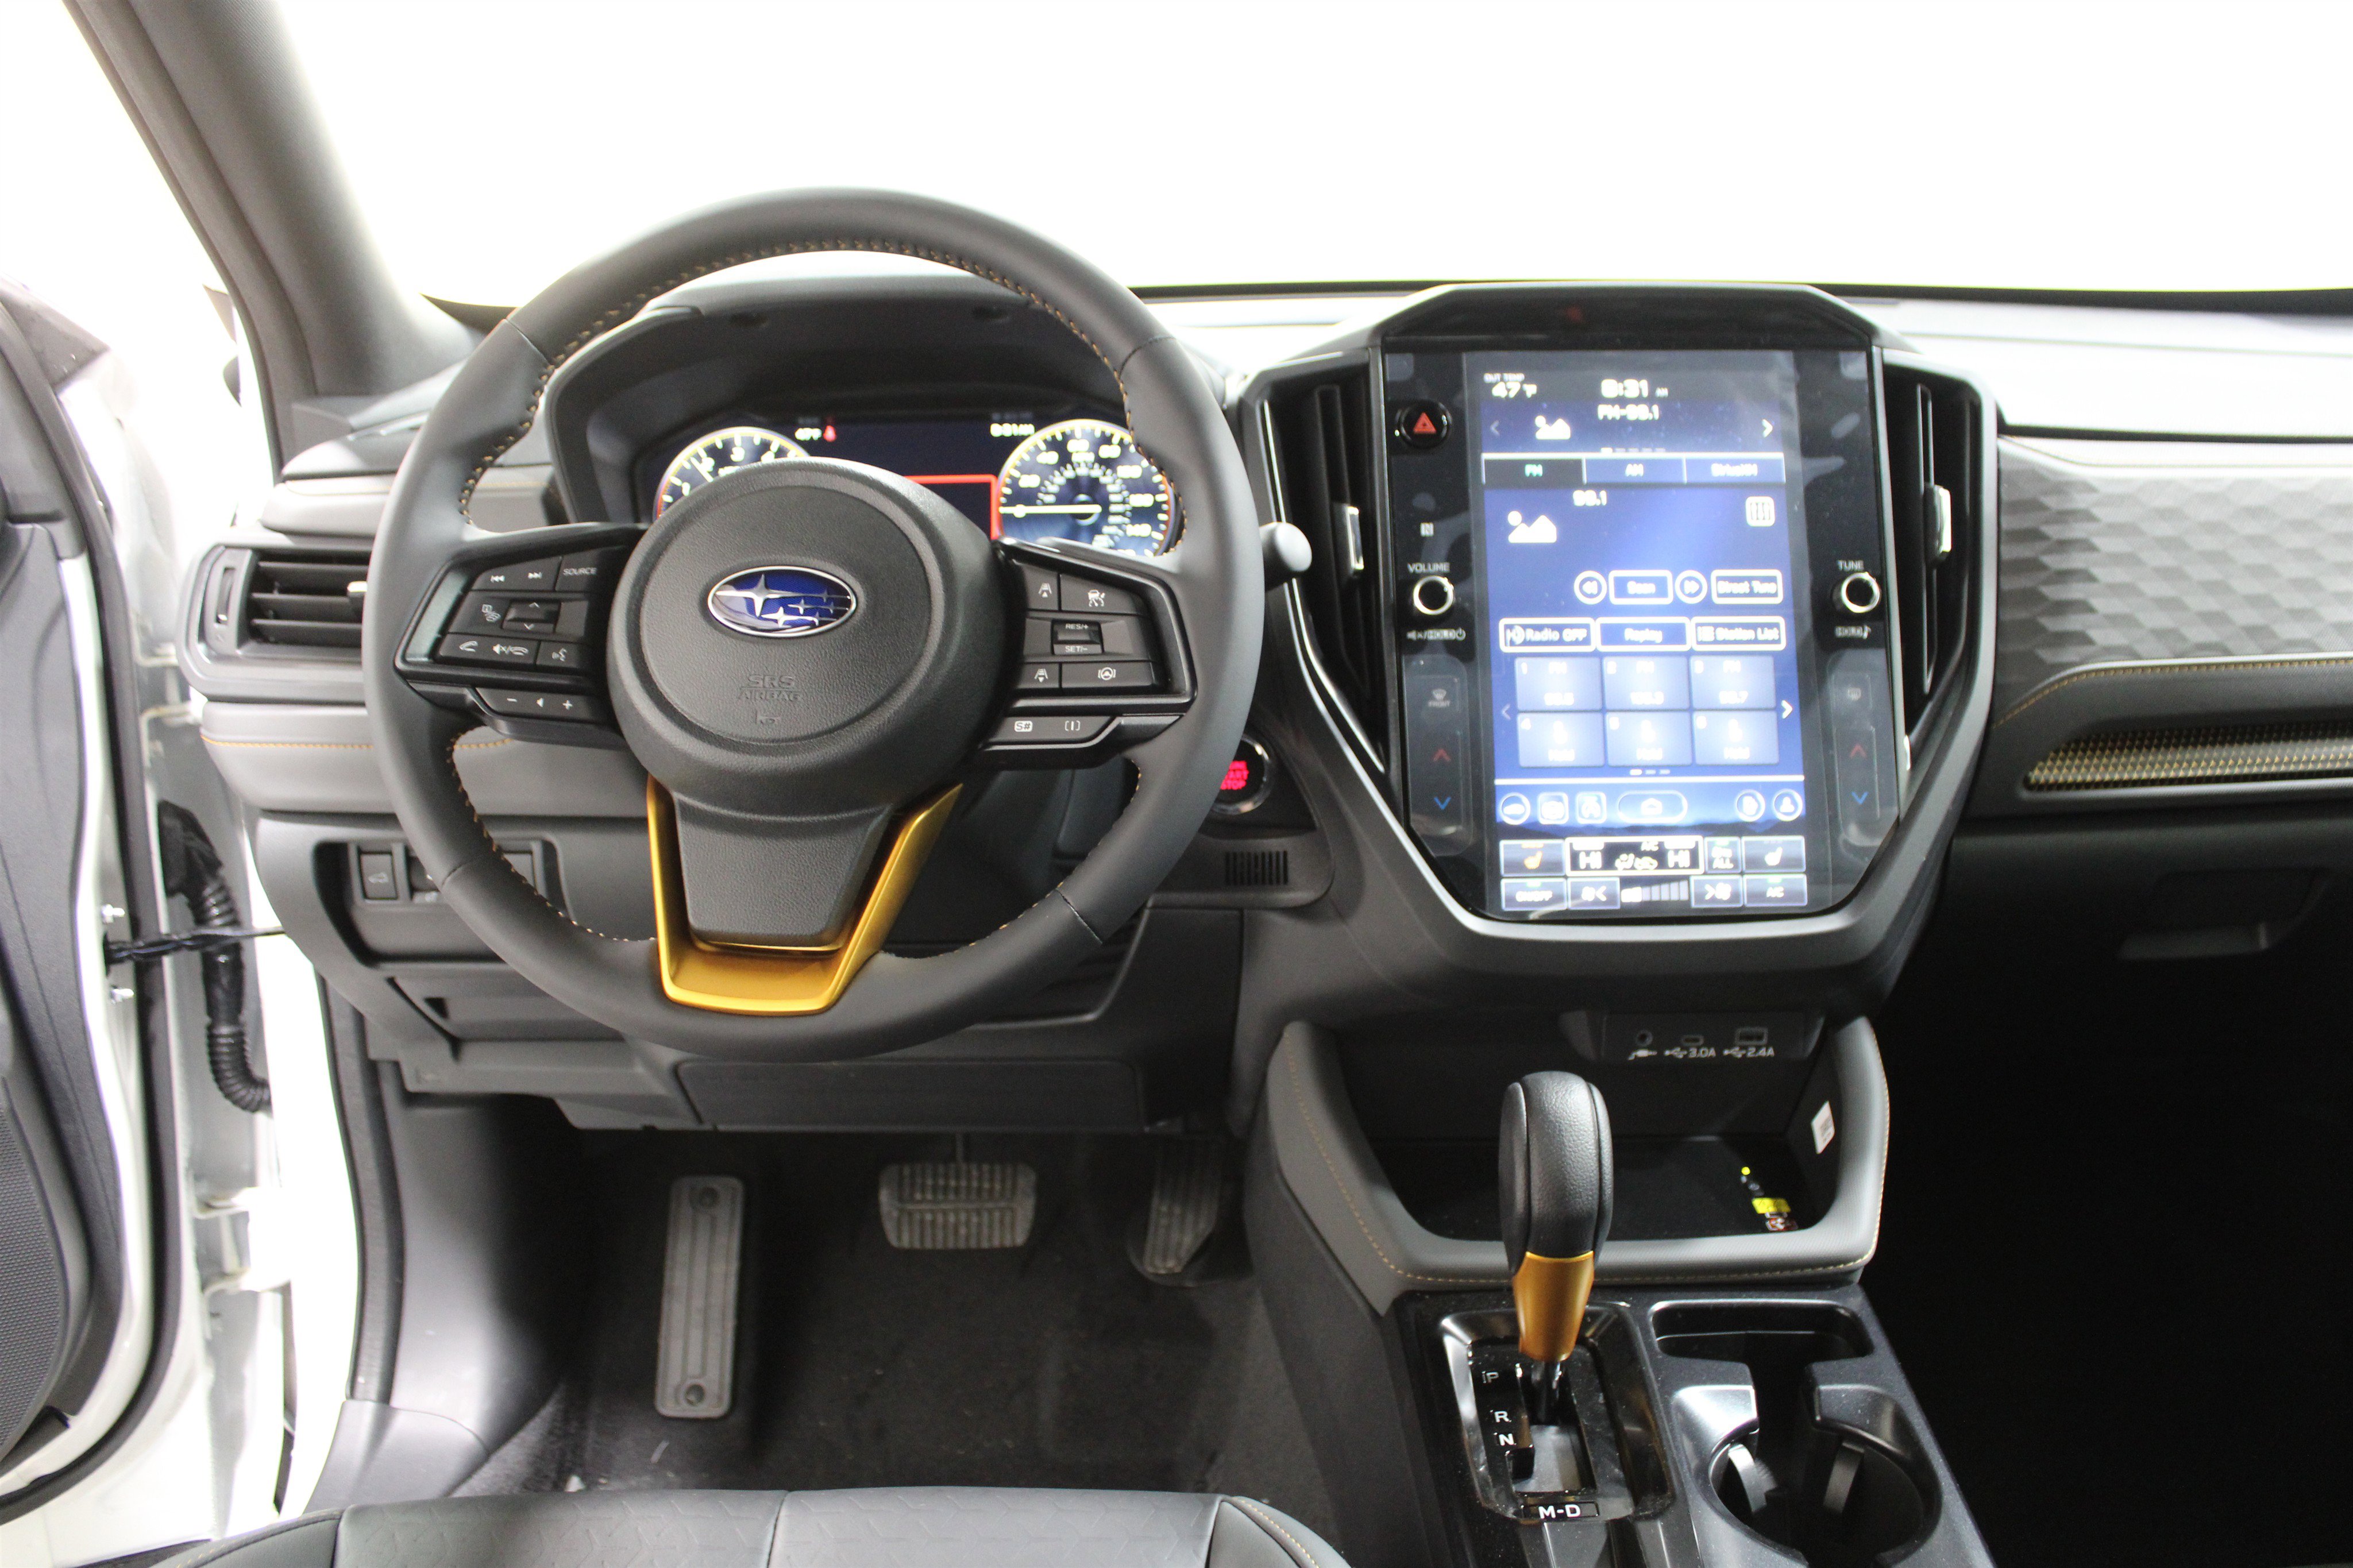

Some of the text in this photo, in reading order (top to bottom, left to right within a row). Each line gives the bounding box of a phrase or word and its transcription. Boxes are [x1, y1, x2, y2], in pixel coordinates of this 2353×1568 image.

[1601, 379, 1648, 397] 8:31
[1525, 464, 1543, 477] FM
[1625, 464, 1644, 477] AM
[563, 567, 597, 576] SOURCE
[1407, 563, 1450, 573] VOLUME
[1838, 560, 1864, 571] TUNE
[1752, 581, 1777, 594] Tune
[1525, 627, 1560, 642] Radio
[1562, 628, 1587, 642] OFF
[1715, 627, 1779, 640] Station List
[748, 675, 794, 688] SRS
[1688, 1047, 1716, 1058] 3.0A
[1746, 1046, 1775, 1057] 2.4A
[1495, 1411, 1509, 1423] R
[1499, 1434, 1514, 1446] N
[1538, 1504, 1581, 1519] M-D
